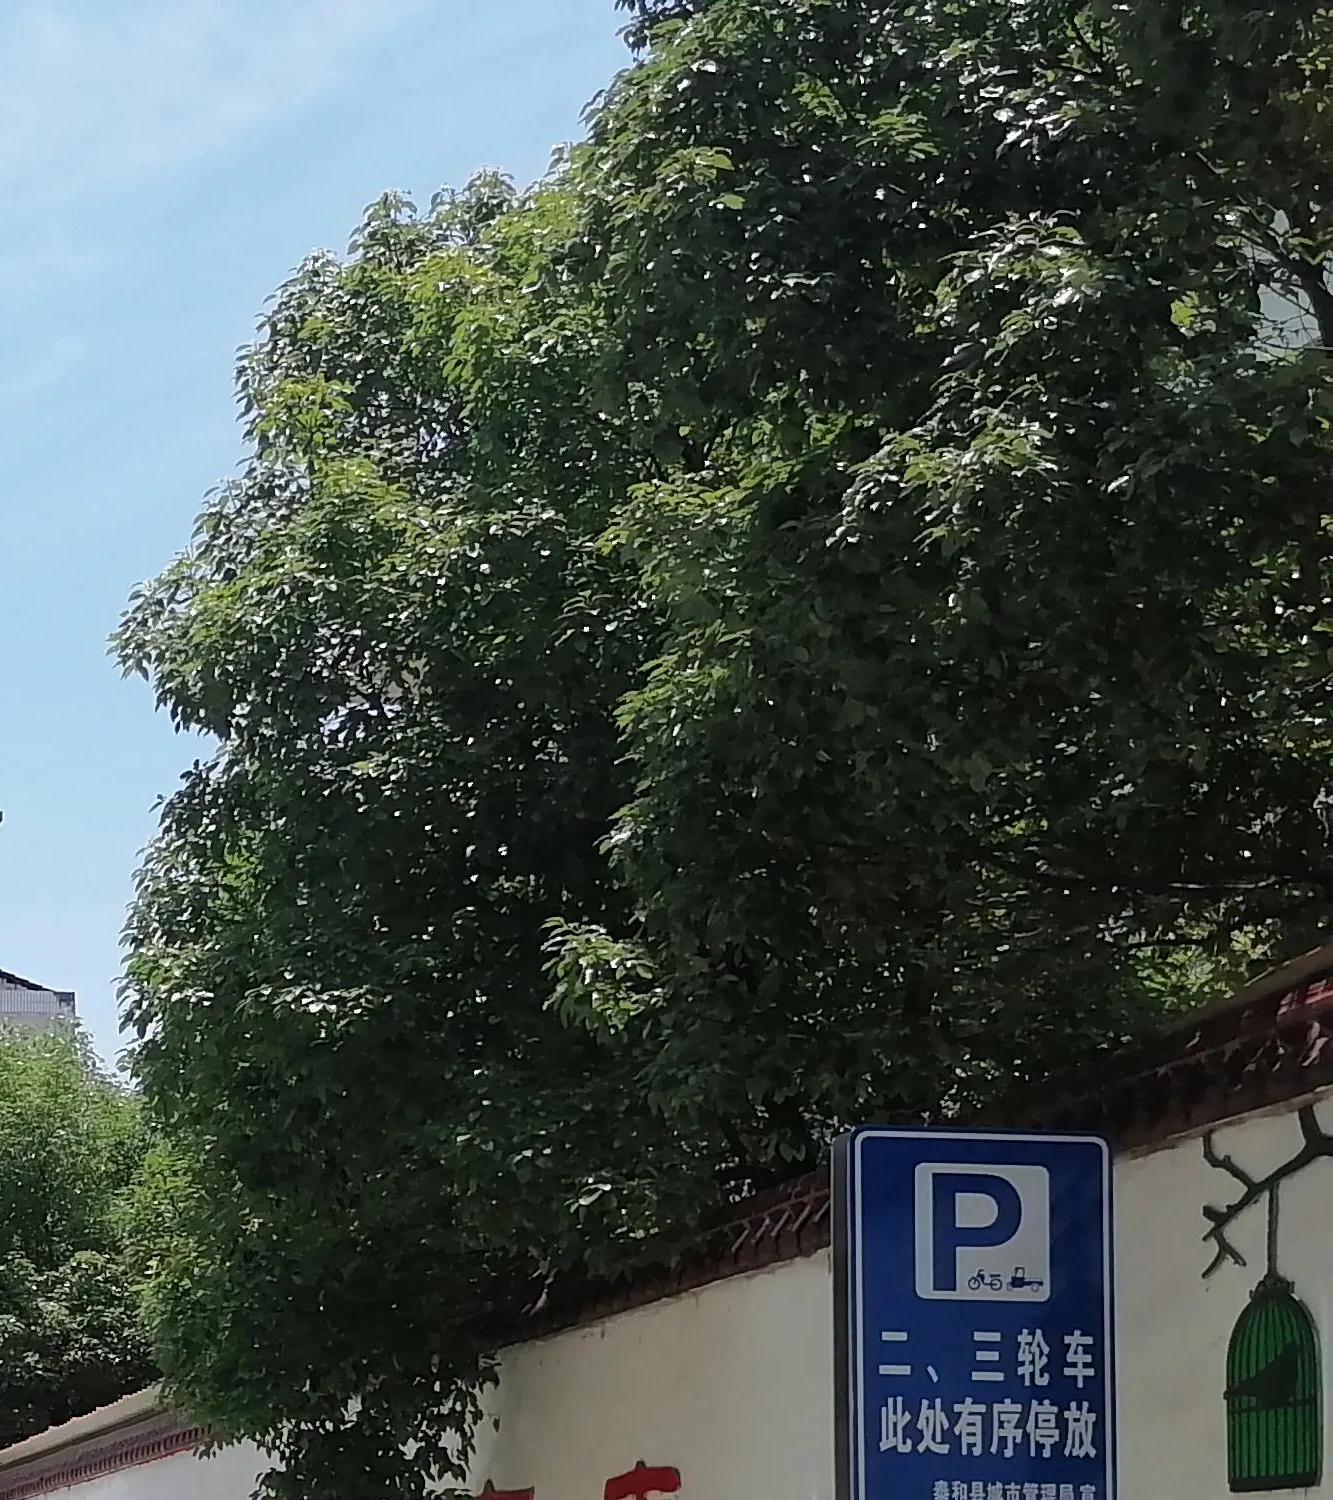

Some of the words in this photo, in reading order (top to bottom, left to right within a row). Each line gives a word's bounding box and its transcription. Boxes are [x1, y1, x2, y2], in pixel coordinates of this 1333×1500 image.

[931, 1172, 1023, 1292] P
[878, 1328, 1096, 1389] 二、三轮车
[879, 1395, 1097, 1460] 此处有序停放
